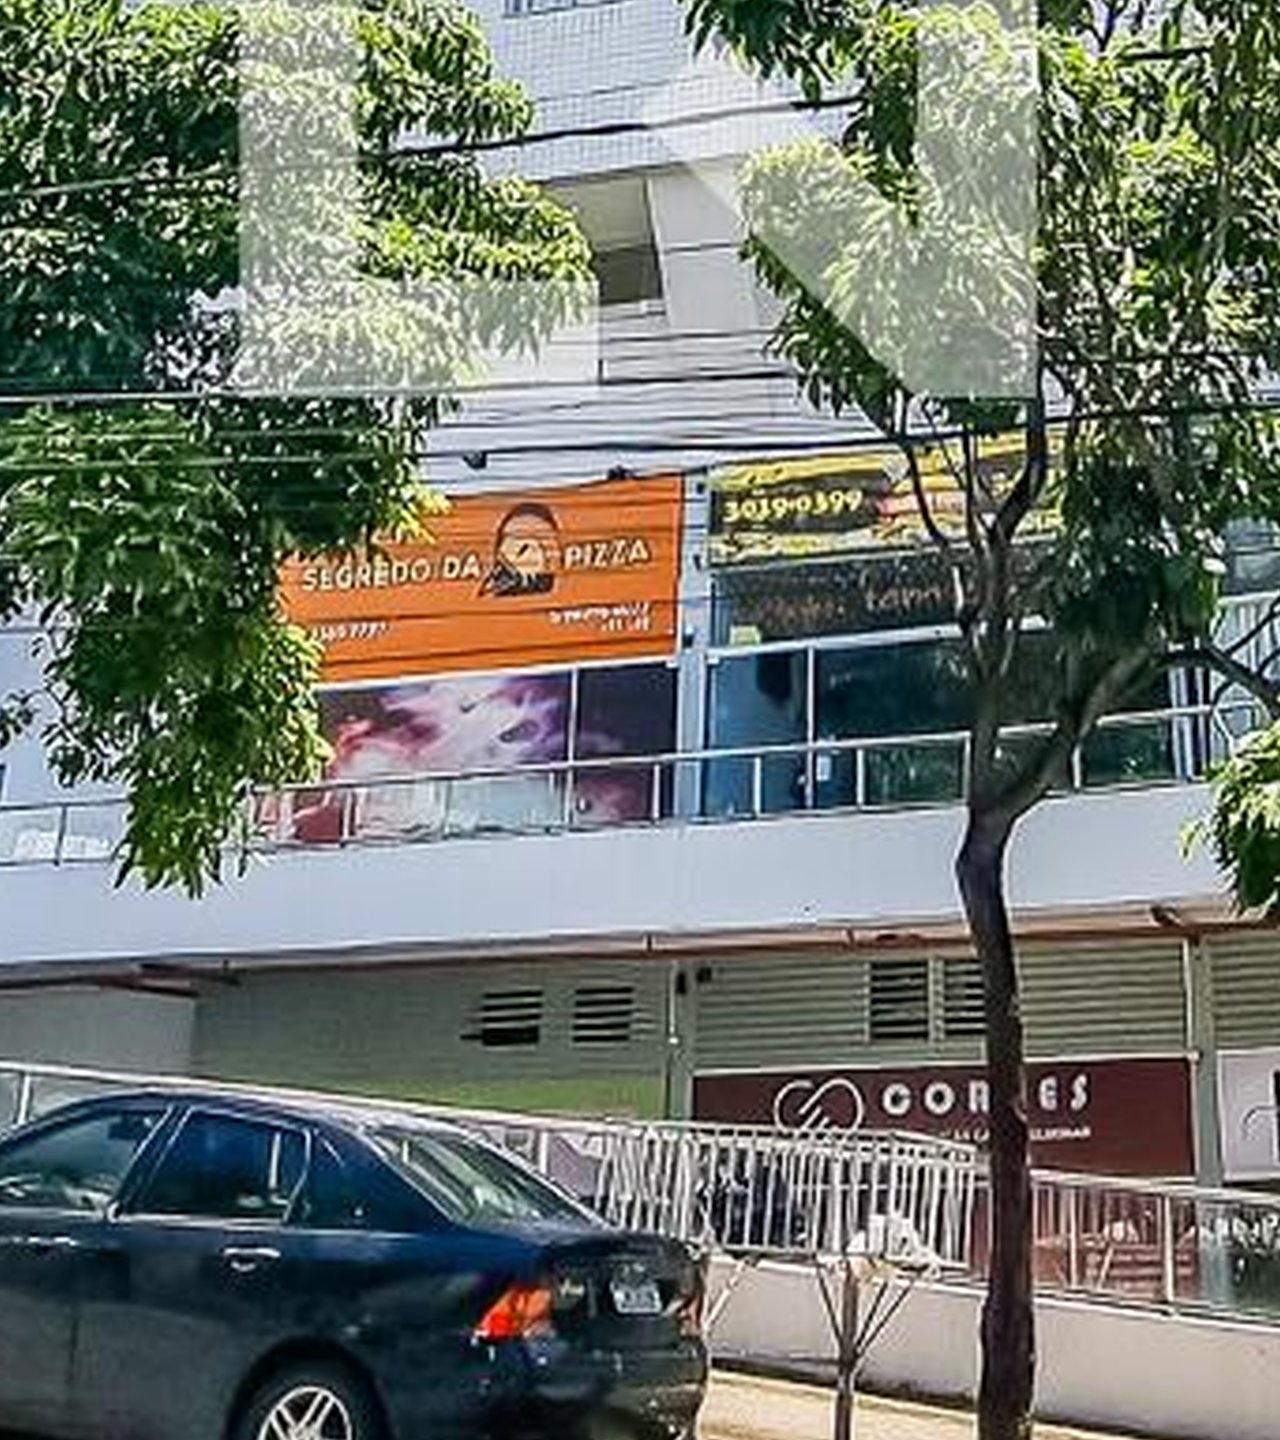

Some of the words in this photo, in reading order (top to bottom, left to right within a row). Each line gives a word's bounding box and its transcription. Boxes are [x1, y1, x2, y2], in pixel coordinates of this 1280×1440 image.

[301, 558, 432, 592] SEGREDO
[441, 555, 481, 581] DA
[563, 538, 650, 569] PIZZA
